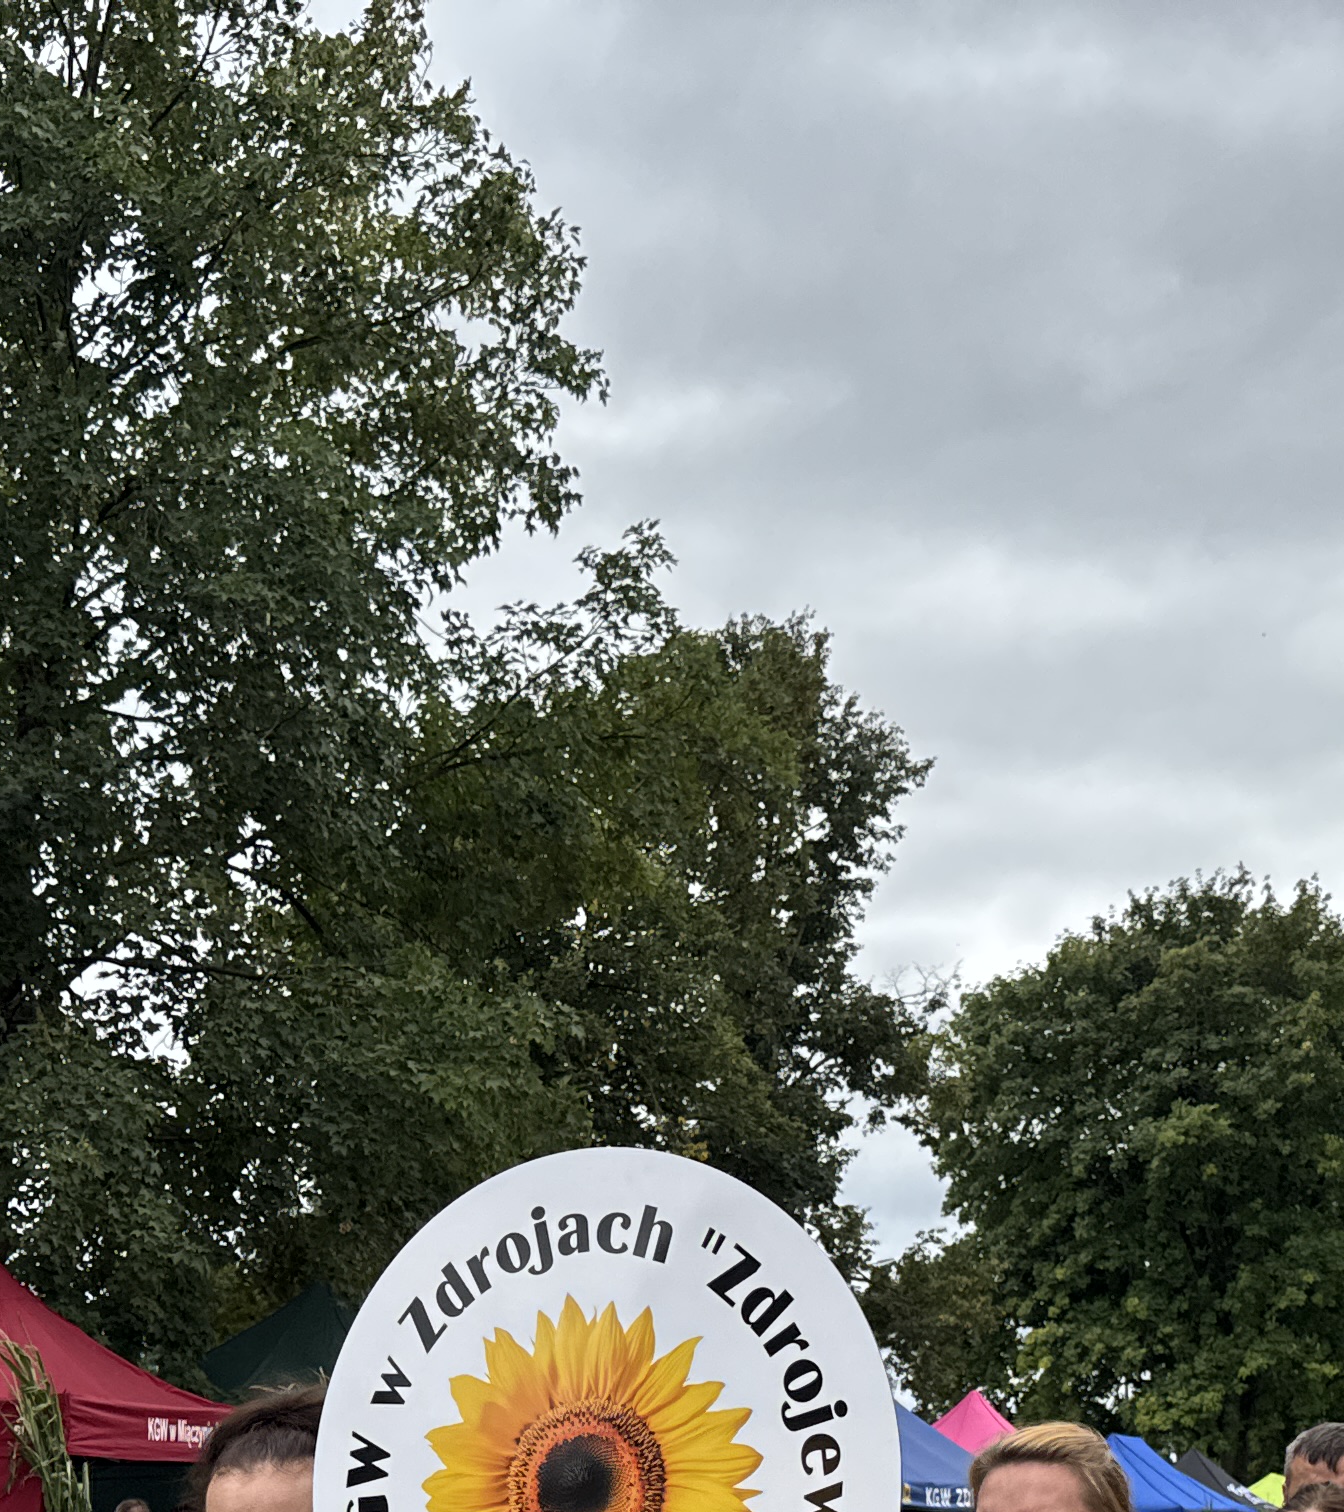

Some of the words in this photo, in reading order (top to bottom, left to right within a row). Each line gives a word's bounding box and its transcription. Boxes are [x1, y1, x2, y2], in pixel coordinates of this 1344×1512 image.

[370, 1355, 413, 1406] w
[397, 1204, 674, 1354] Zdrojach
[148, 1417, 169, 1441] KGW
[925, 1486, 952, 1508] KGW
